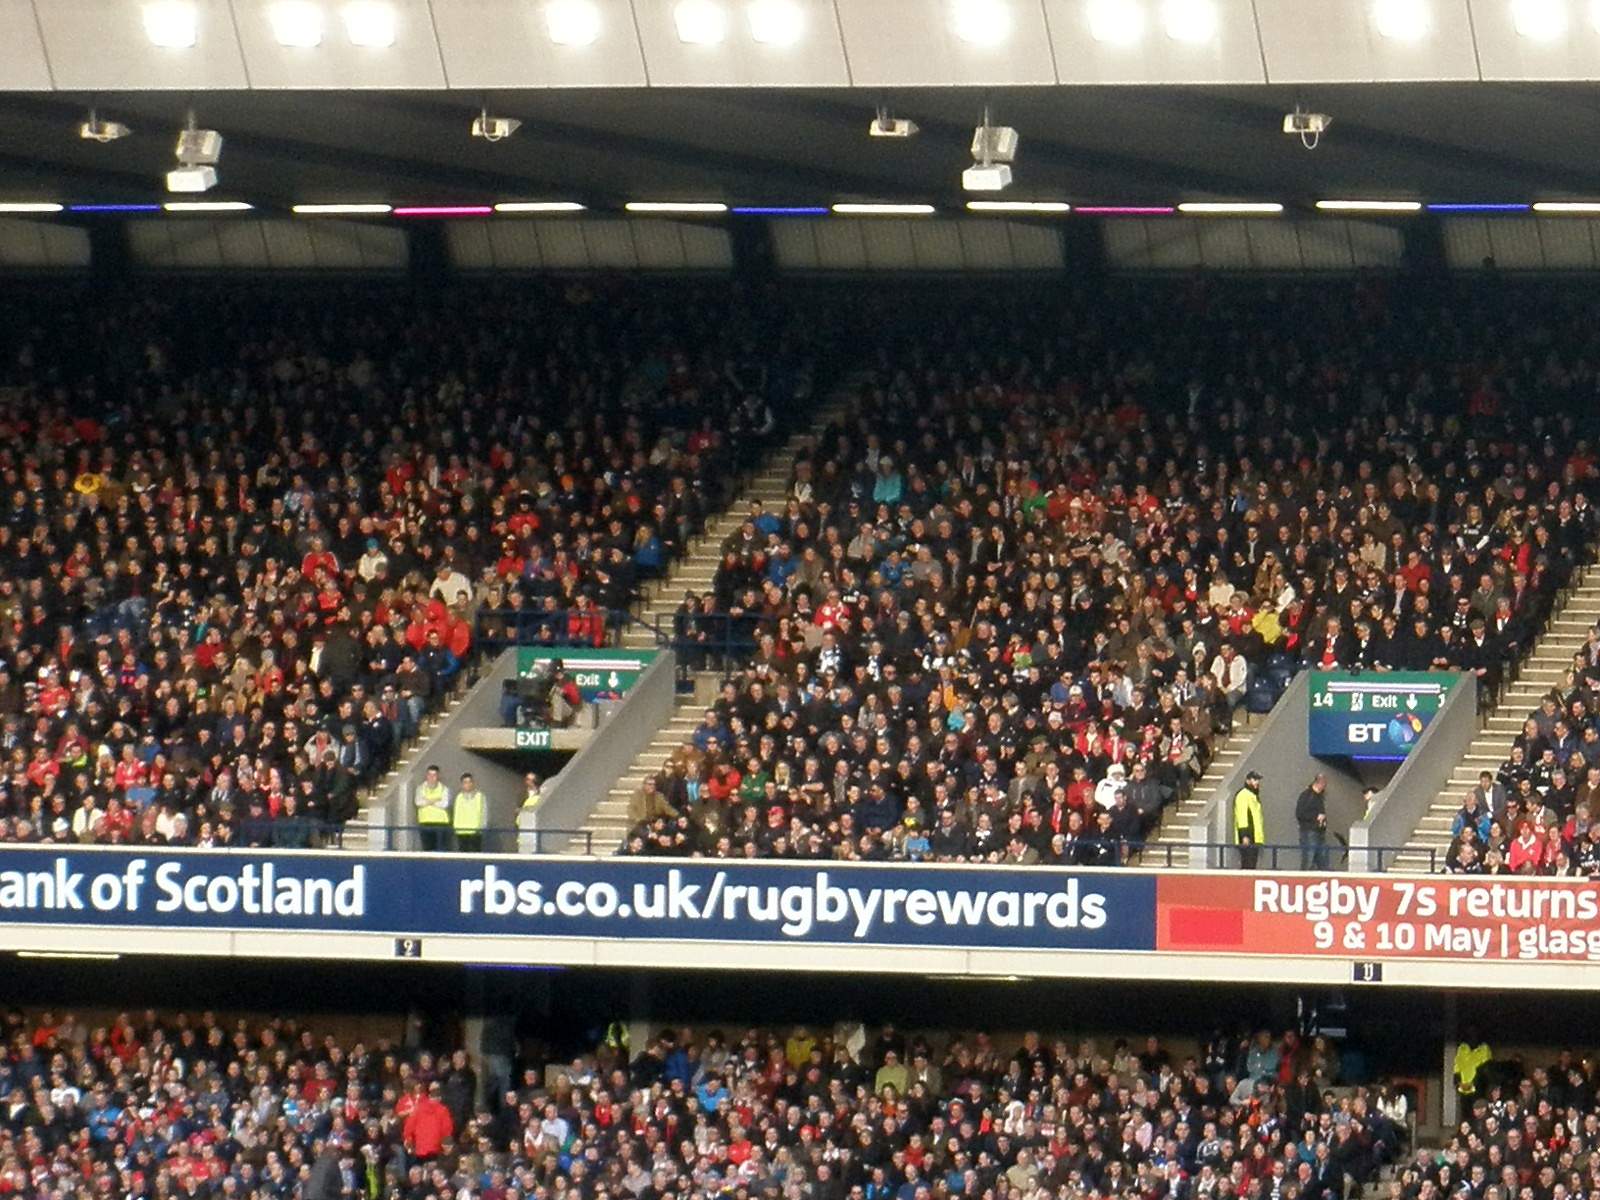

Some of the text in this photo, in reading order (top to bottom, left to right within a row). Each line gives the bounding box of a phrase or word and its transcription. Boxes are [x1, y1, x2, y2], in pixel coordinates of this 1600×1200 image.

[576, 674, 600, 686] Exit
[1313, 693, 1334, 707] 14
[1372, 695, 1398, 708] Exit
[516, 731, 550, 746] EXIT
[1348, 723, 1387, 743] BT
[91, 859, 146, 911] of
[155, 862, 365, 916] Scotland
[459, 864, 1108, 938] rbs.co.uk/rugbyrewards
[1254, 878, 1379, 921] Rugby
[1393, 882, 1436, 916] 7s
[1449, 884, 1598, 920] returns
[1313, 922, 1334, 949] 9
[1343, 922, 1365, 950] &
[1376, 922, 1415, 950] 10
[1424, 923, 1491, 957] May
